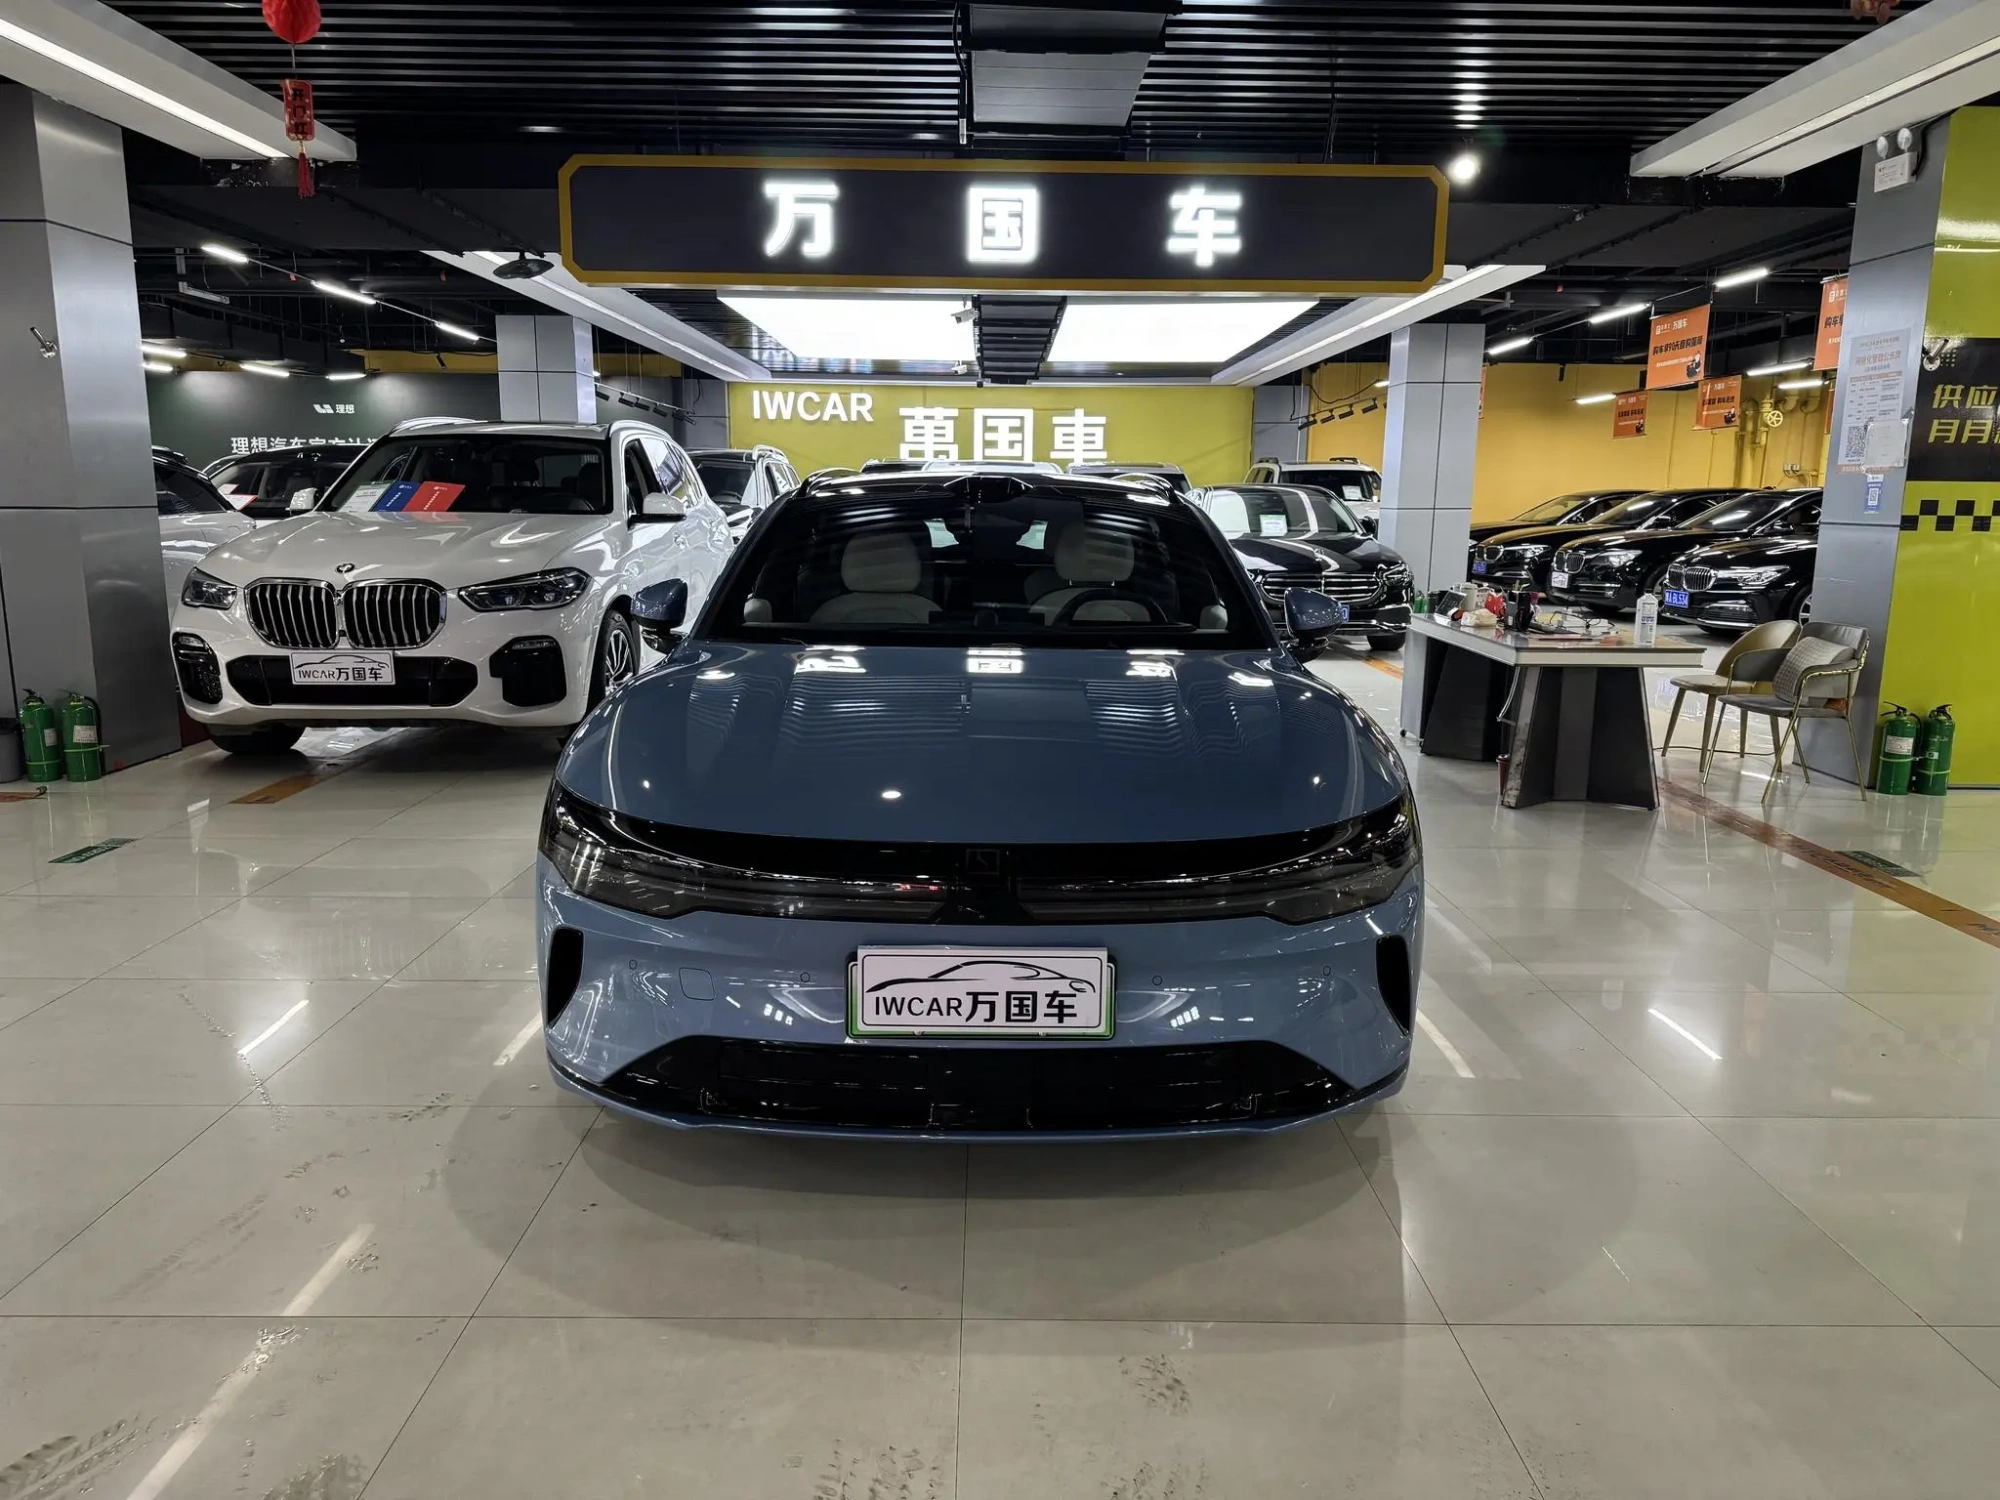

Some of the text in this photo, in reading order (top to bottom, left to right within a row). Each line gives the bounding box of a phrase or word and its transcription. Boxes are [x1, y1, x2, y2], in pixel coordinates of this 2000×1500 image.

[292, 88, 306, 134] 开门红
[763, 178, 1243, 267] 万国车
[335, 404, 355, 414] 理想
[752, 390, 874, 422] IWCAR
[1932, 384, 1998, 409] 供应
[899, 407, 1108, 463] 萬国車
[1927, 419, 2000, 443] 月月
[298, 667, 383, 681] IWCAR万国车
[875, 990, 1077, 1024] IWCAR万国车
